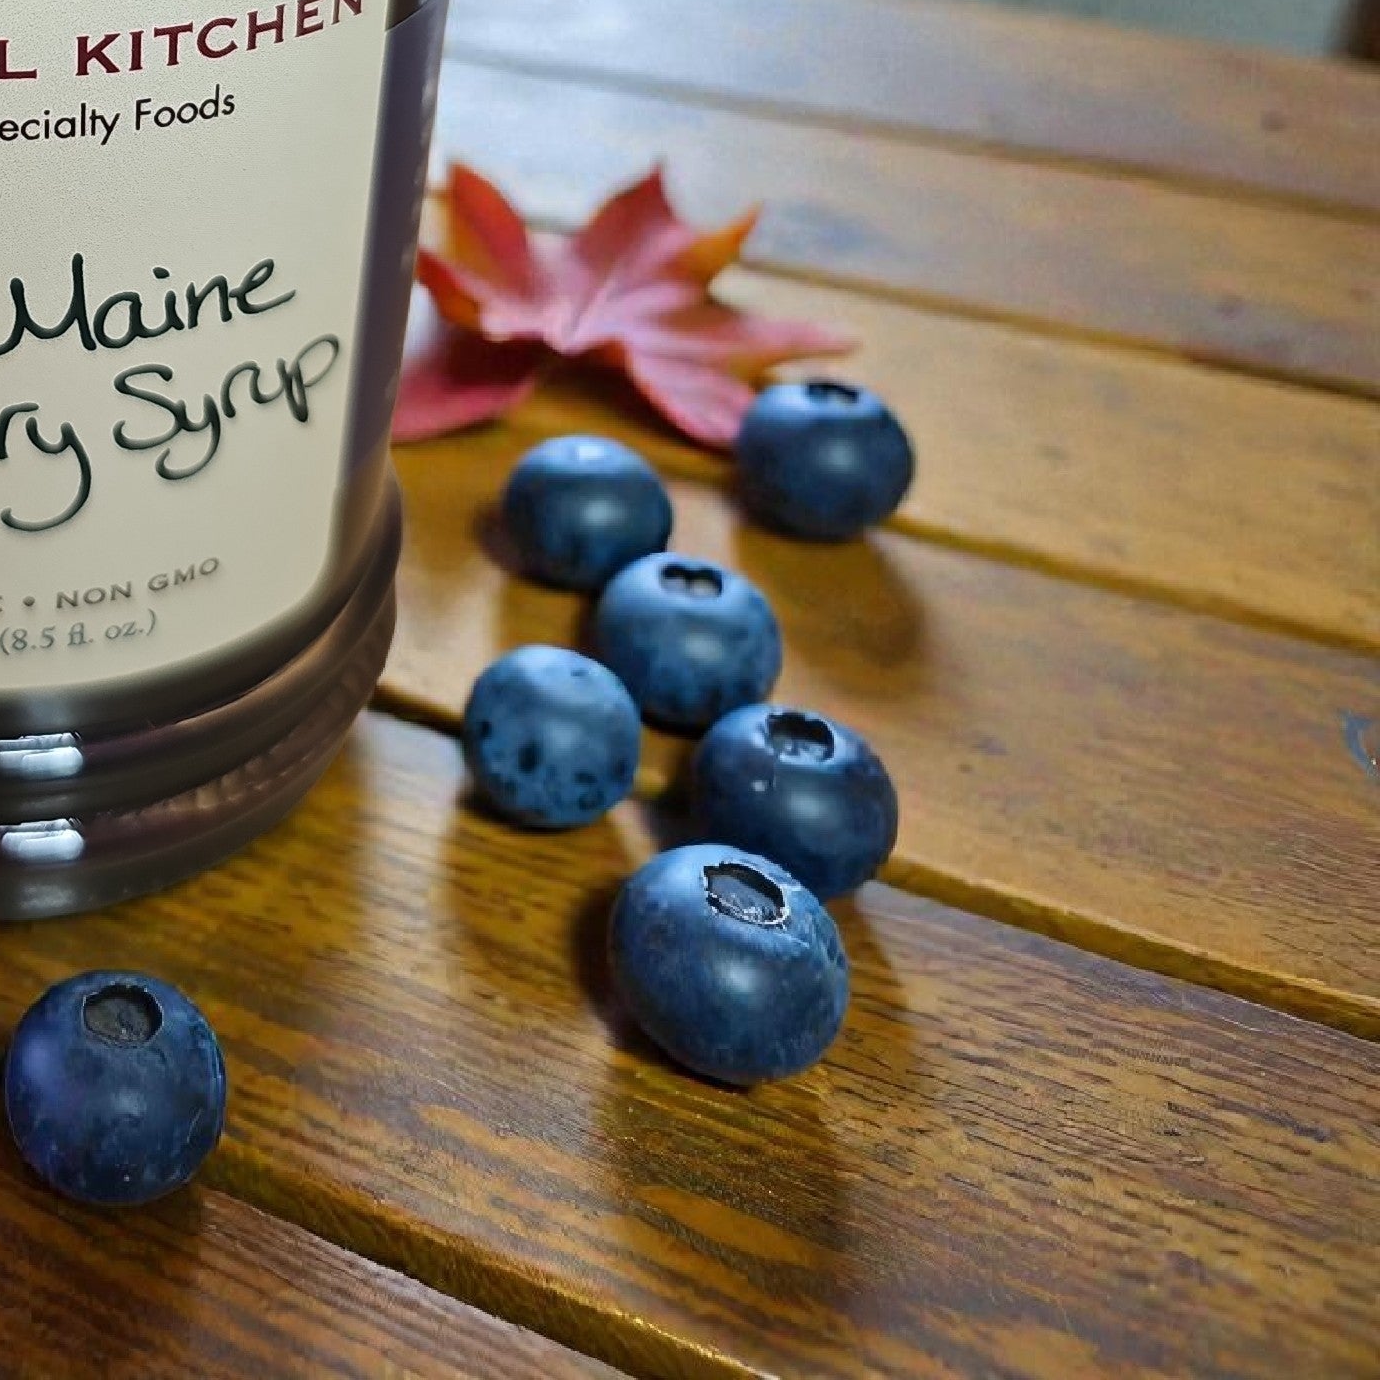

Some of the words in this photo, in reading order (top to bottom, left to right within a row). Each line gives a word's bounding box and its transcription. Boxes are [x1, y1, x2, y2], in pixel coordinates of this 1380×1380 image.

[134, 84, 237, 132] Foods
[113, 334, 341, 481] Syrup
[55, 581, 133, 610] NON
[147, 556, 221, 592] GMO
[65, 619, 94, 646] fl.
[103, 609, 159, 641] oz.)
